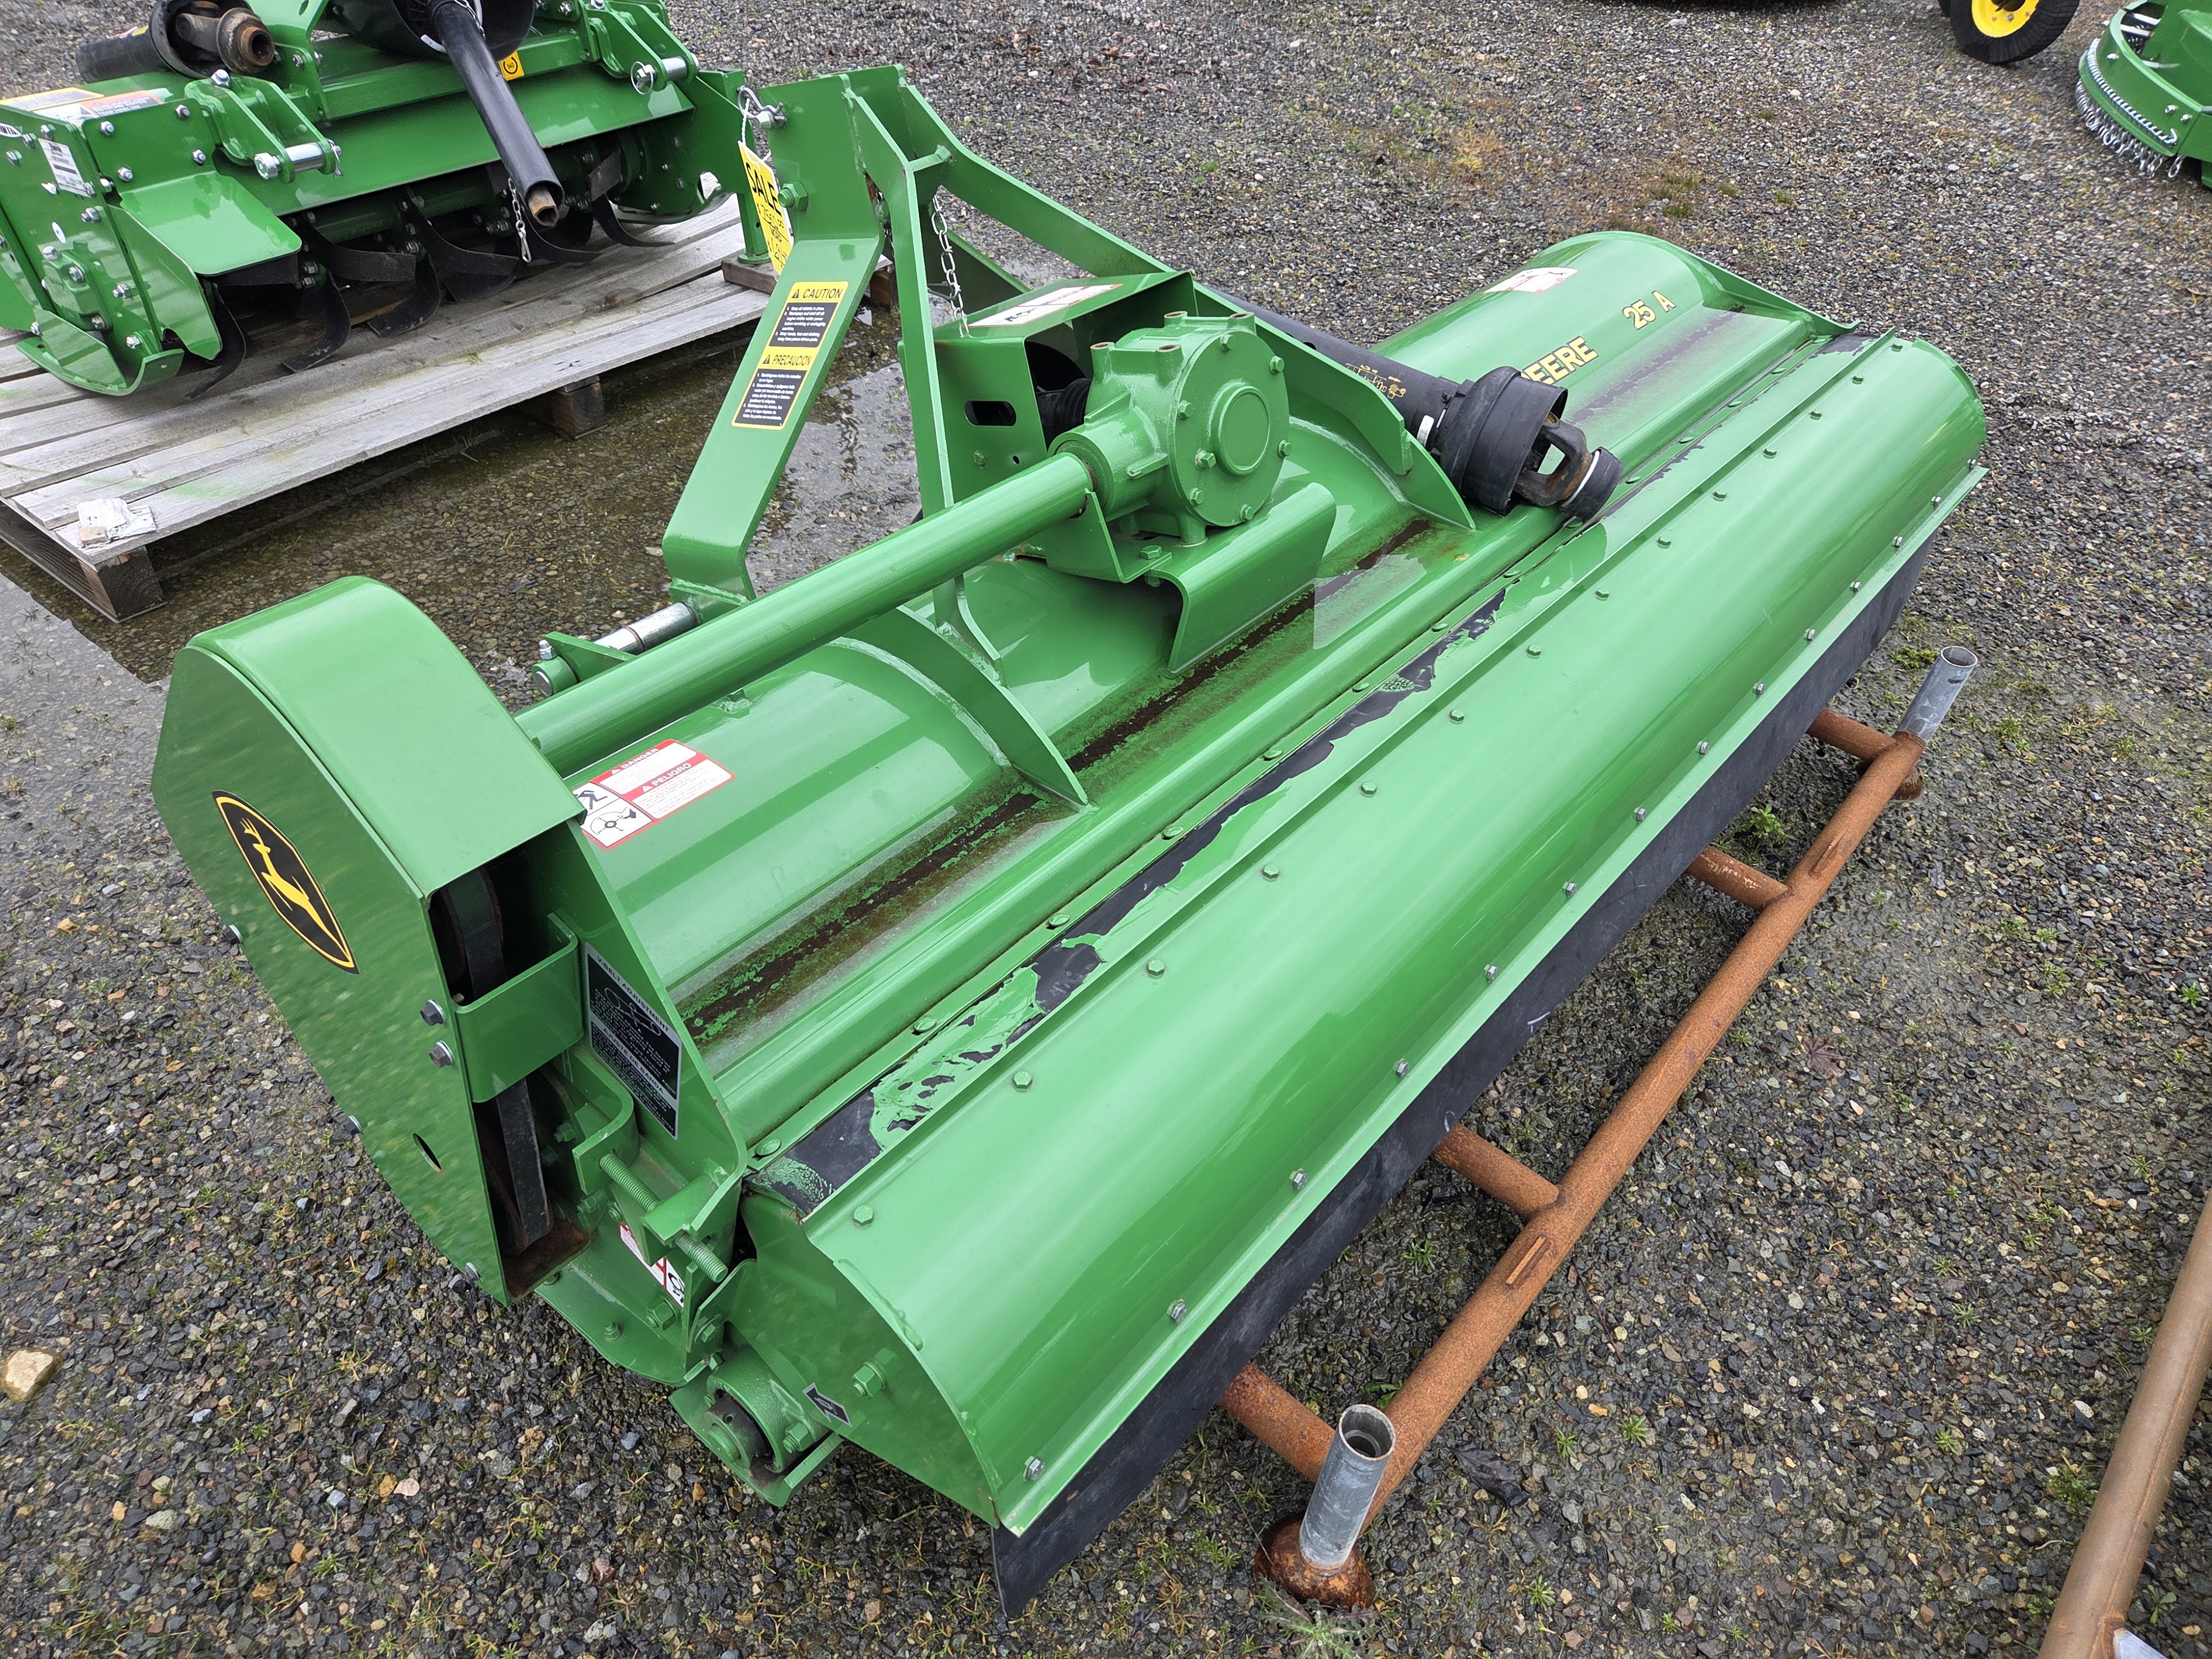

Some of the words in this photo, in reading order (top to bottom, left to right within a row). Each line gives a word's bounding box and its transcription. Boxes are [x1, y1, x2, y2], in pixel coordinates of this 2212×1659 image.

[746, 162, 782, 217] SALE
[803, 288, 843, 299] CAUTION
[1622, 299, 1656, 330] 25
[1651, 290, 1676, 313] A
[772, 354, 812, 366] PRECAUCION
[1521, 335, 1599, 385] EERE
[620, 748, 659, 769] DANGER
[651, 763, 692, 786] PELIGRO
[597, 956, 621, 982] V-BELT
[622, 983, 669, 1032] ADJUSTMENT
[603, 1028, 628, 1057] AJUSTE
[630, 1055, 639, 1067] DE
[640, 1067, 664, 1094] BANDA
